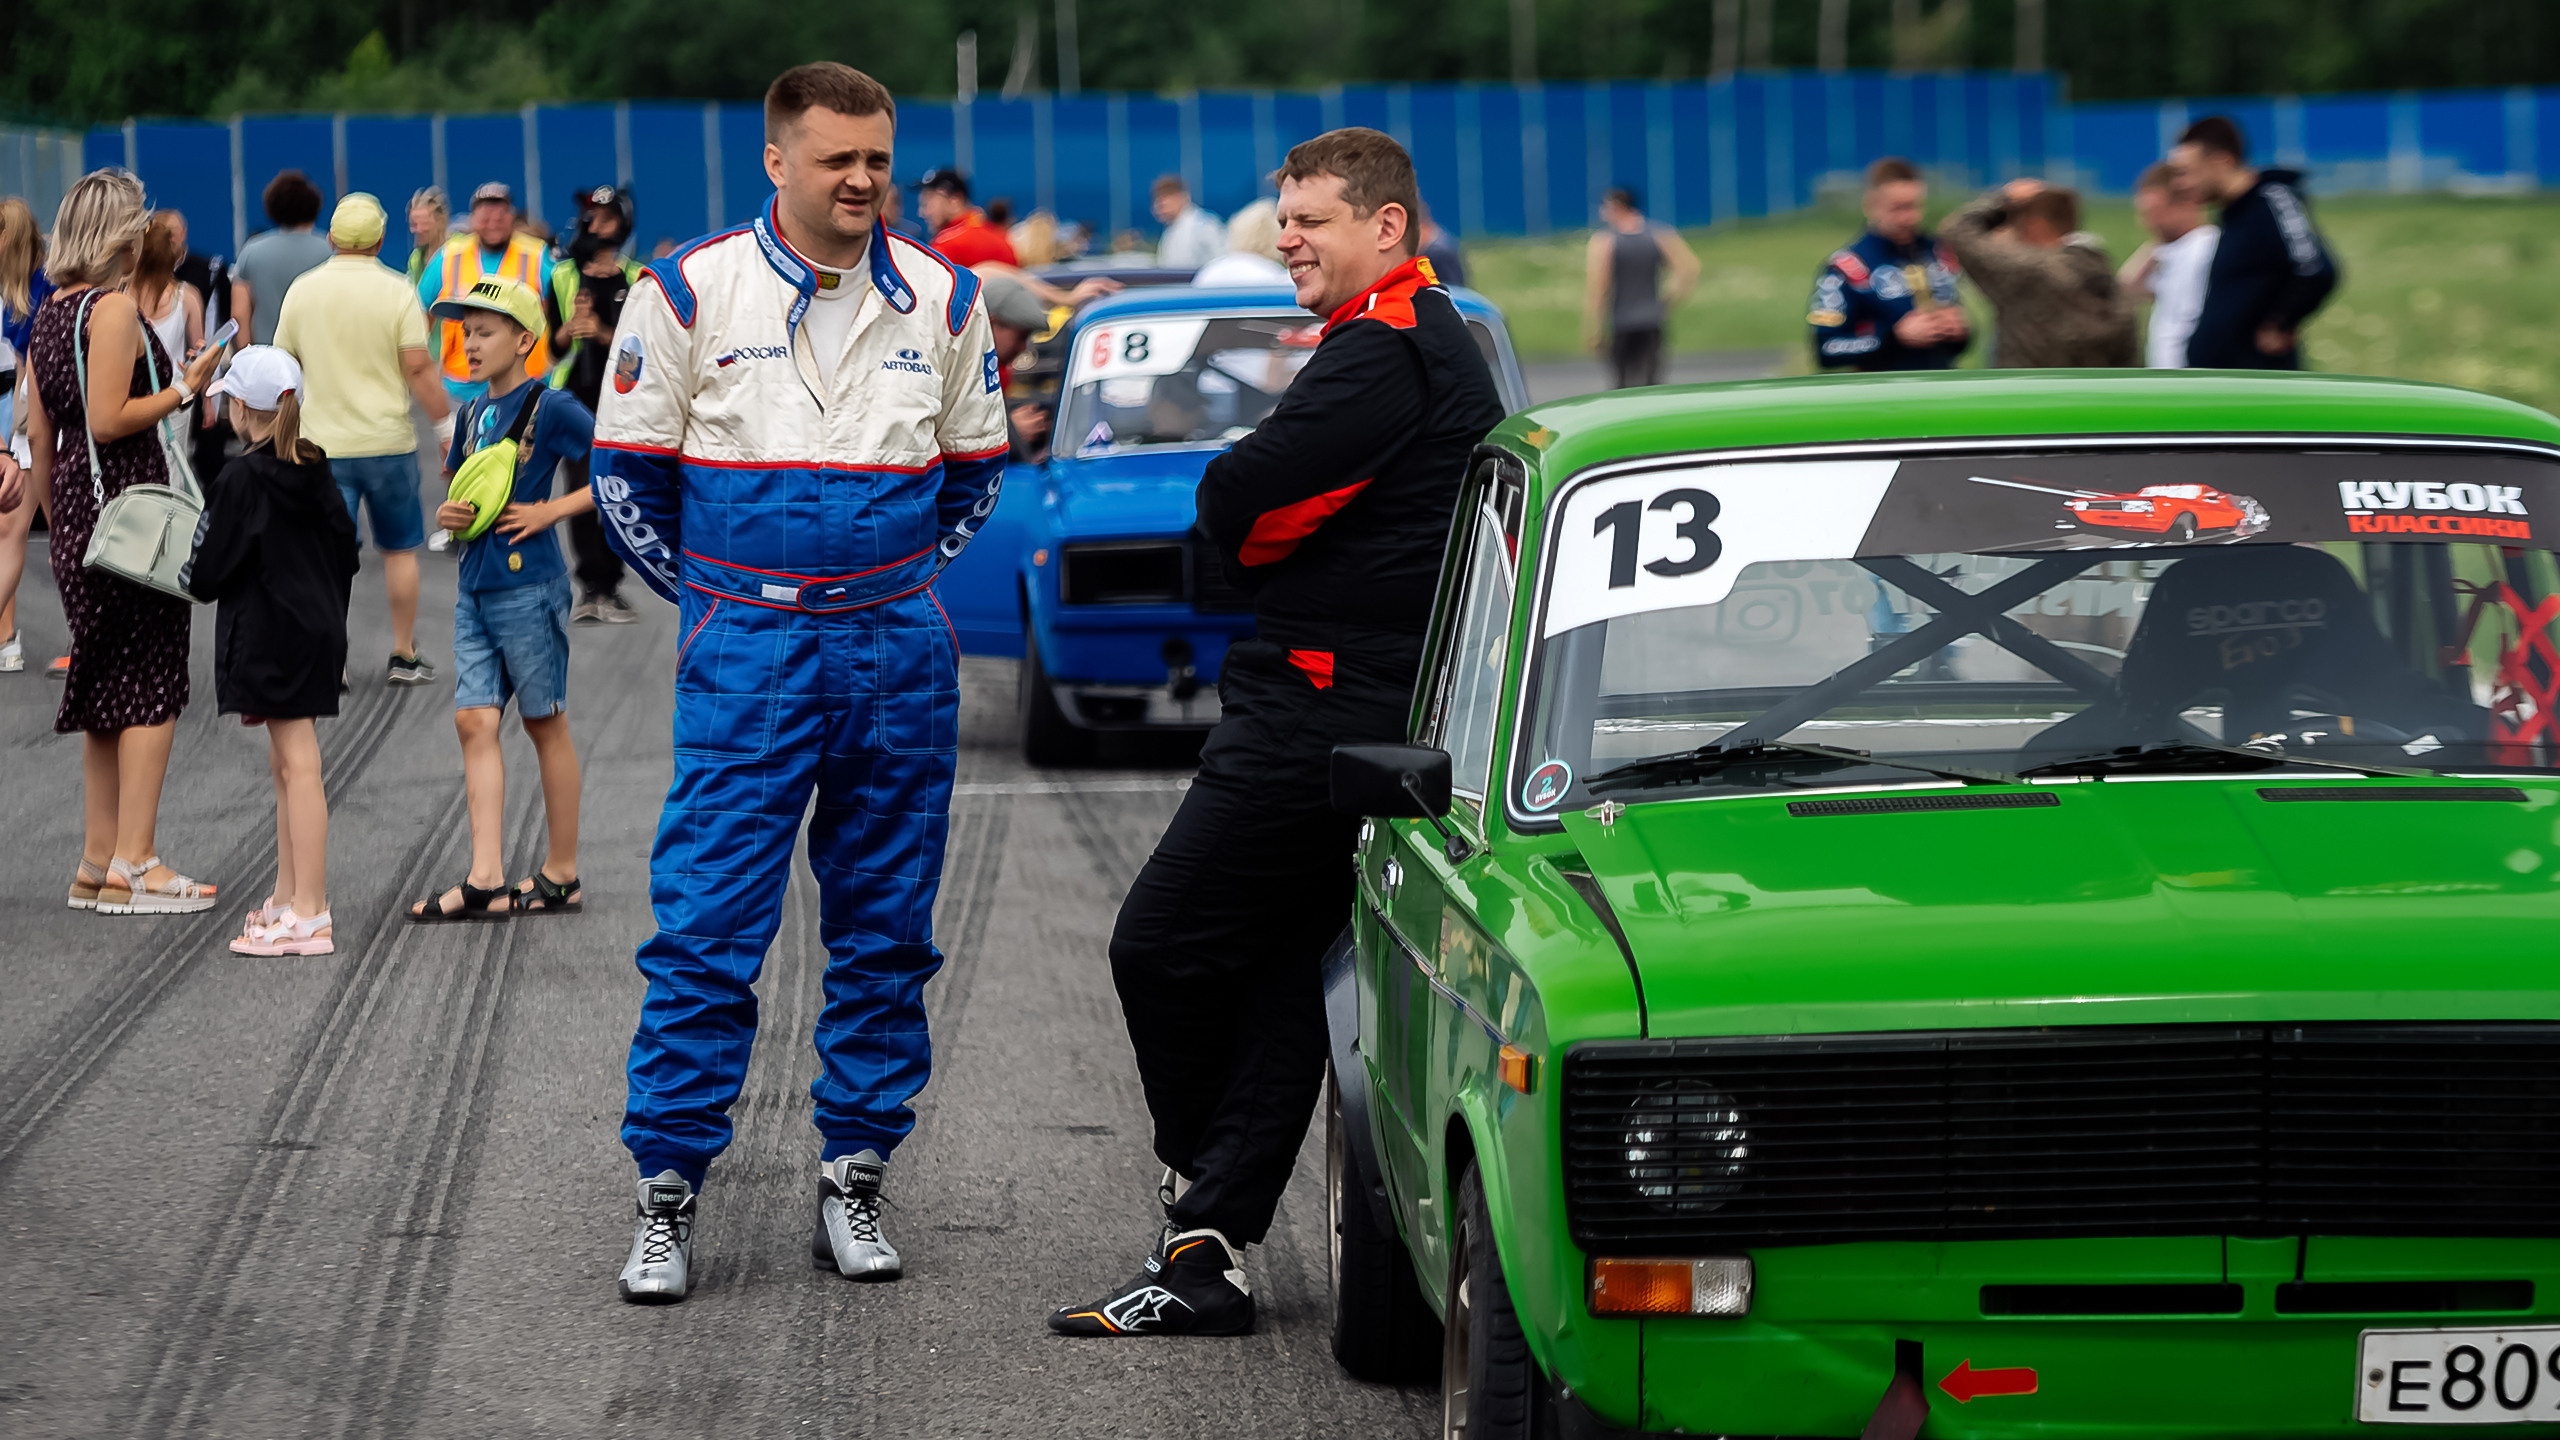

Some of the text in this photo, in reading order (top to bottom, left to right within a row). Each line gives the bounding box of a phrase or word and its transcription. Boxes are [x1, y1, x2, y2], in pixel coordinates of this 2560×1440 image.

[733, 346, 788, 360] РОССИЯ
[881, 361, 932, 375] АВТОВАЗ
[2338, 481, 2529, 515] КУБОК
[596, 475, 681, 580] sparc
[1594, 488, 1722, 590] 13
[2348, 514, 2532, 539] КЛАССИКИ
[2187, 598, 2326, 636] sparco
[851, 1169, 880, 1183] freem
[653, 1191, 682, 1203] freem
[2388, 1343, 2560, 1412] Е80
